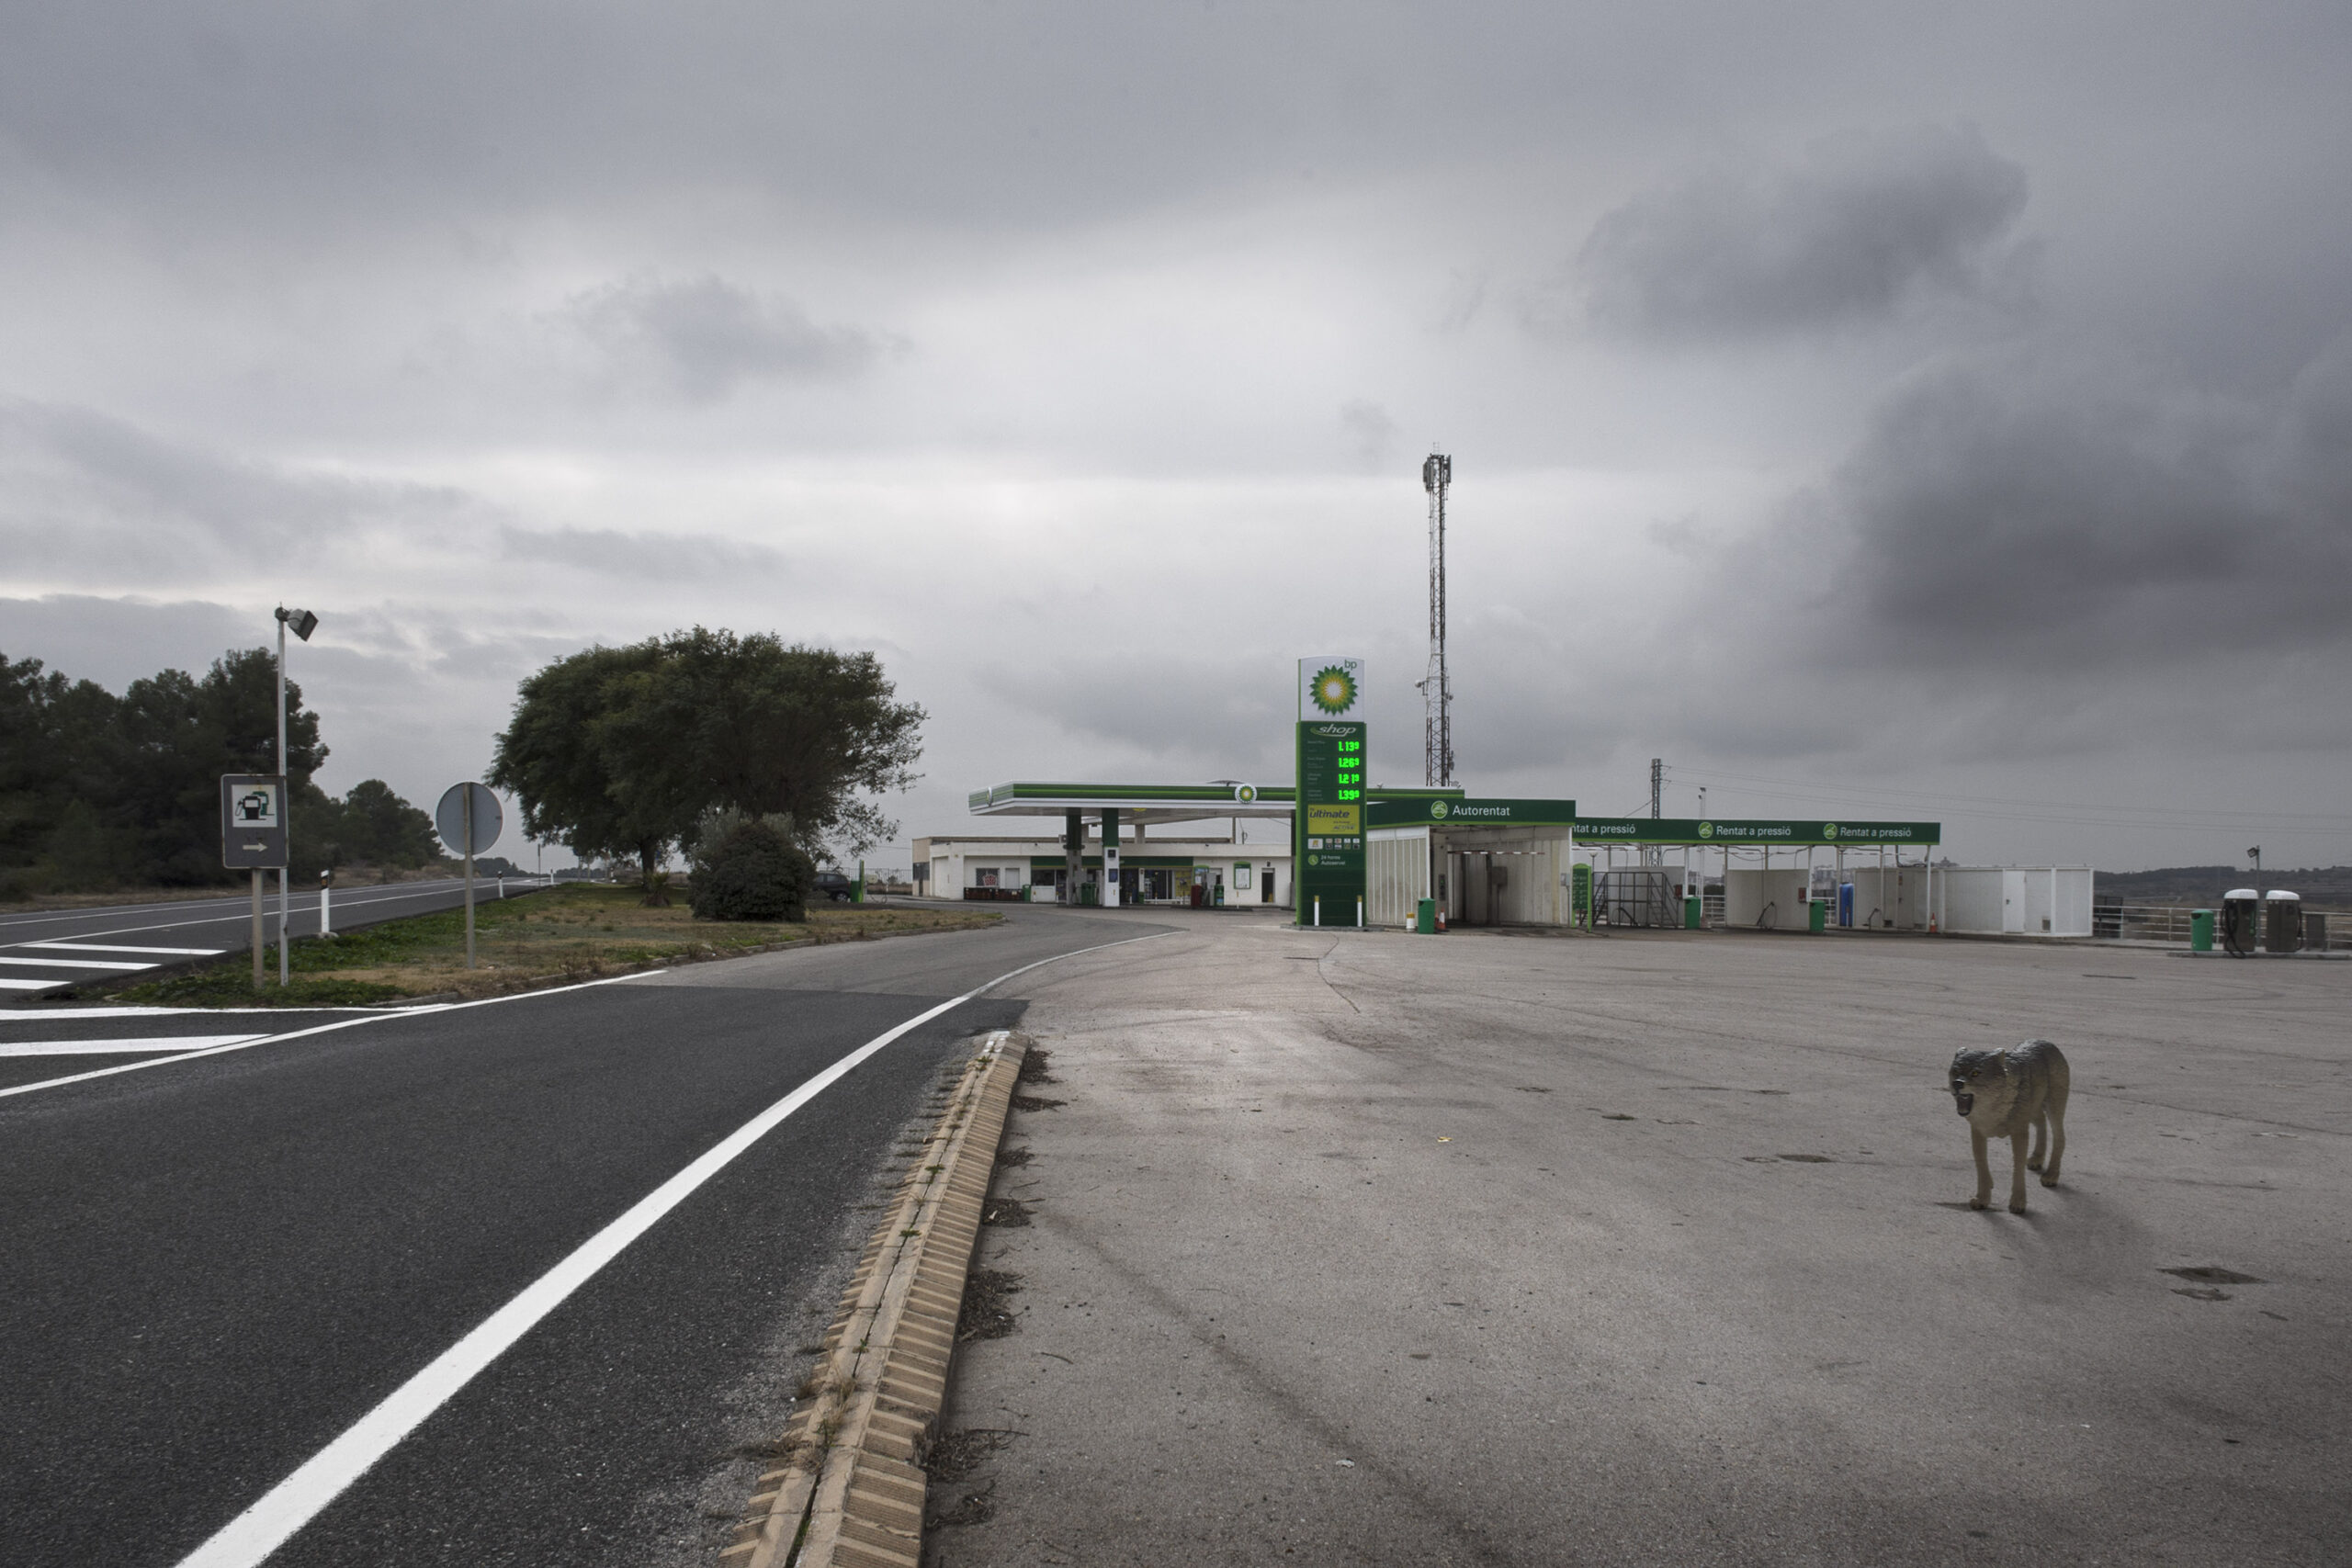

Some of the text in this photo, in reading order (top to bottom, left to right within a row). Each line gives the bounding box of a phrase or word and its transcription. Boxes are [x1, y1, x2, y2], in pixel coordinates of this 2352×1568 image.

[1344, 659, 1358, 671] bp
[1319, 724, 1357, 738] shop
[1453, 805, 1510, 817] Autorentat
[1572, 823, 1636, 835] ntat a pressió
[1716, 826, 1792, 838] Rentat a pressió
[1840, 827, 1870, 837] Rentat
[1879, 828, 1912, 839] pressió
